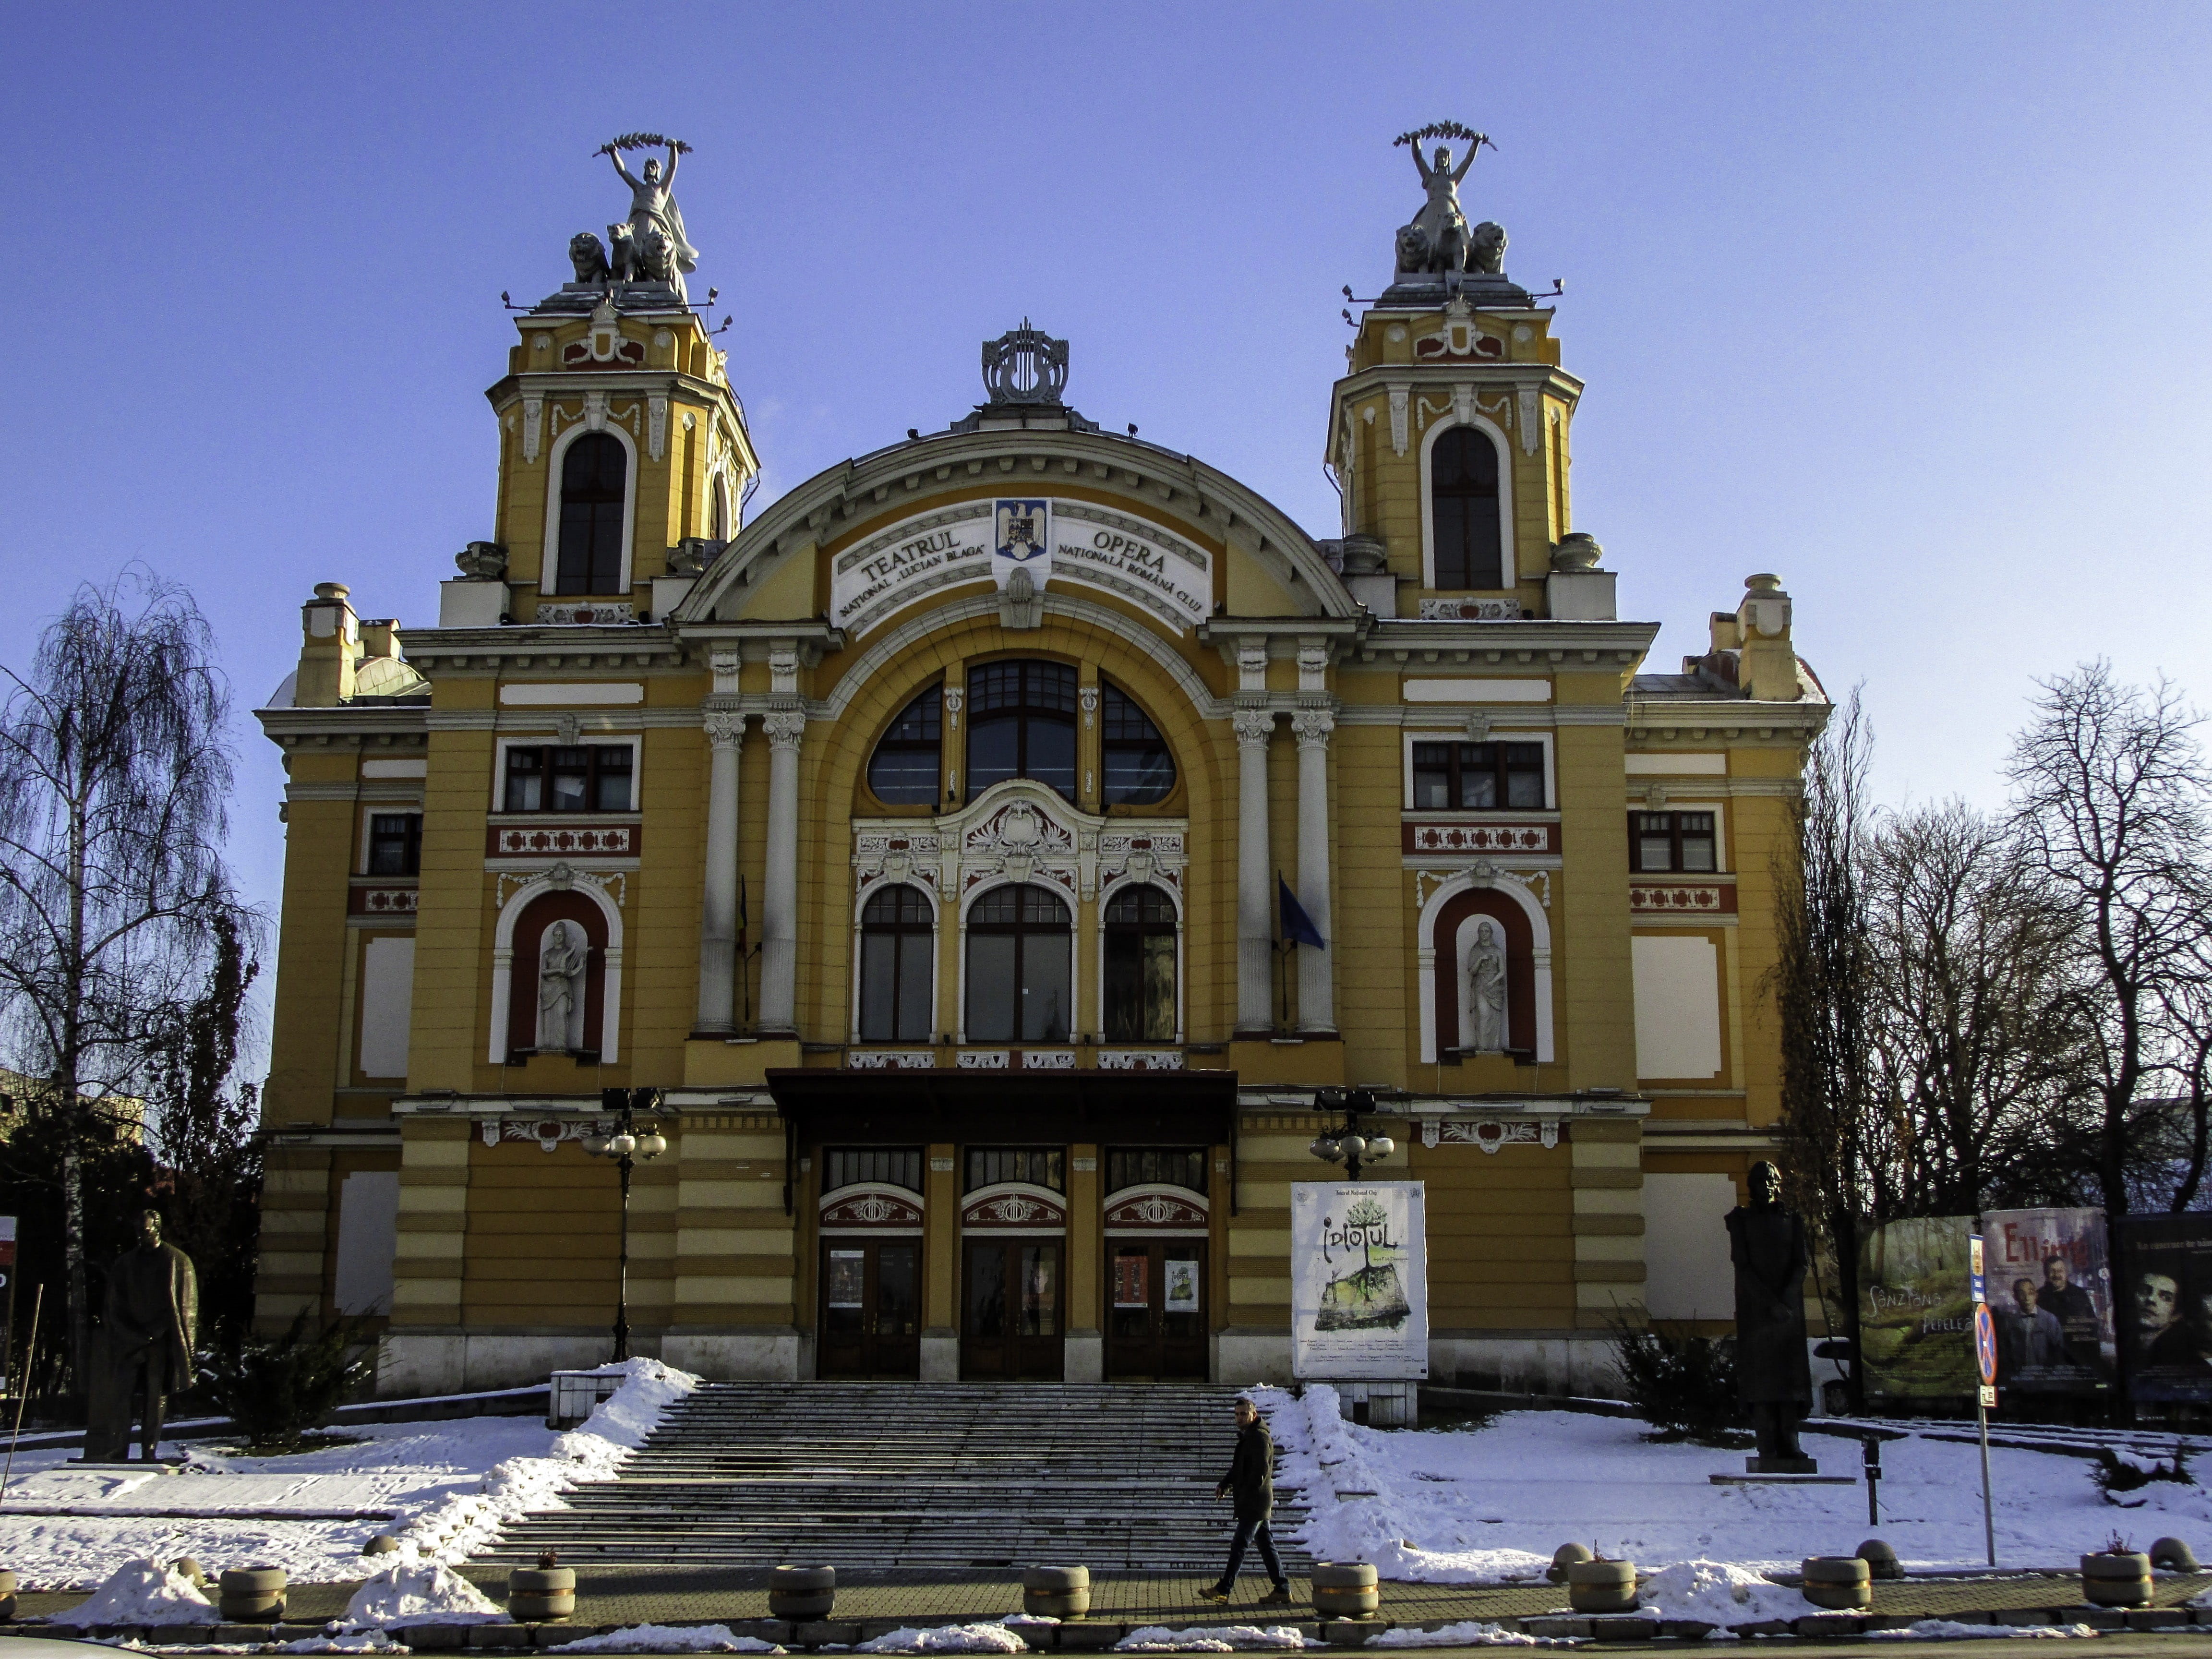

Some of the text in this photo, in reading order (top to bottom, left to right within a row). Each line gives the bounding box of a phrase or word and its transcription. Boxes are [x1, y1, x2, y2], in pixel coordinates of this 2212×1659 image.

[861, 531, 960, 582] TEATRUL
[1094, 531, 1165, 573] OPERA
[1177, 590, 1202, 612] CLUJ
